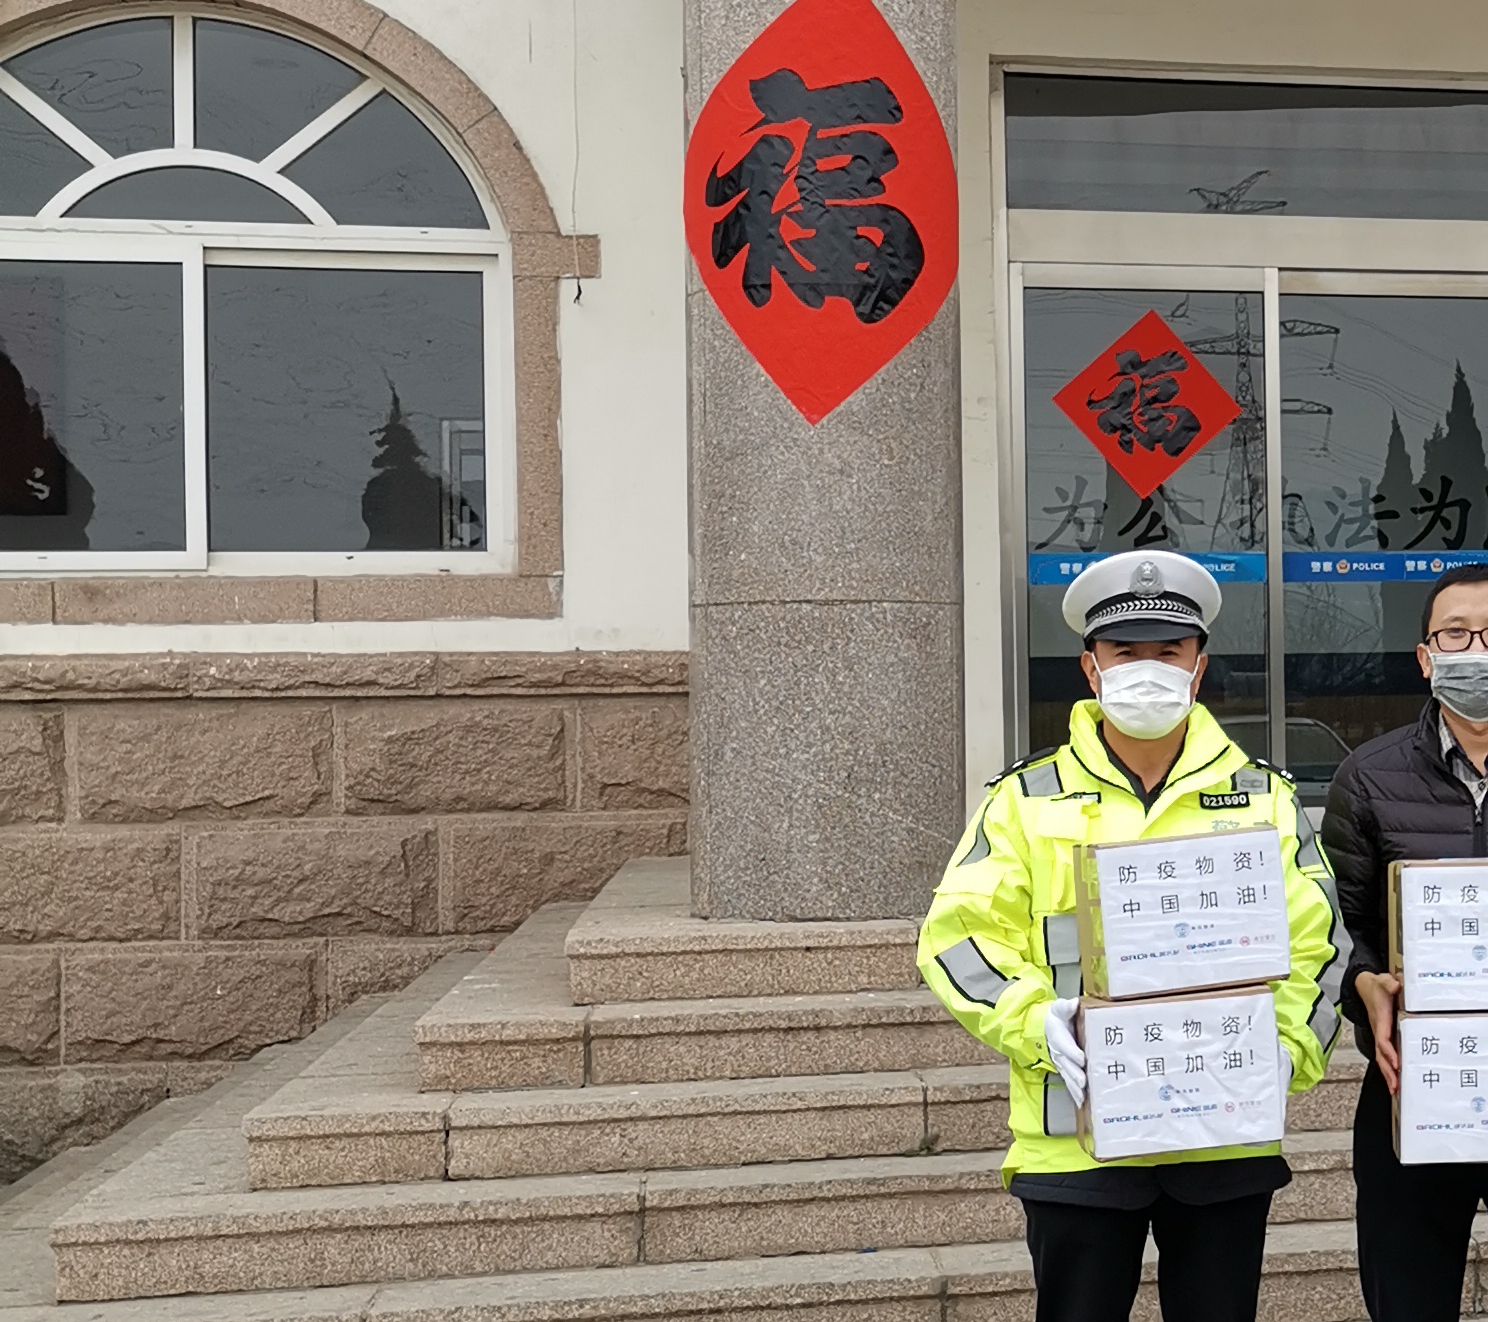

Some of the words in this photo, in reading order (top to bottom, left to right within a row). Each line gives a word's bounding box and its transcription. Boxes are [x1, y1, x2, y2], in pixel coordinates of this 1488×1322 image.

[705, 67, 925, 324] 福
[1086, 349, 1202, 457] 福
[1352, 562, 1385, 571] POLICE
[1203, 794, 1247, 807] 021590
[1118, 850, 1265, 885] 防疫物资！
[1122, 884, 1268, 919] 中国加油！
[1104, 1015, 1253, 1046] 防疫物资！
[1107, 1049, 1255, 1081] 中国加油！
